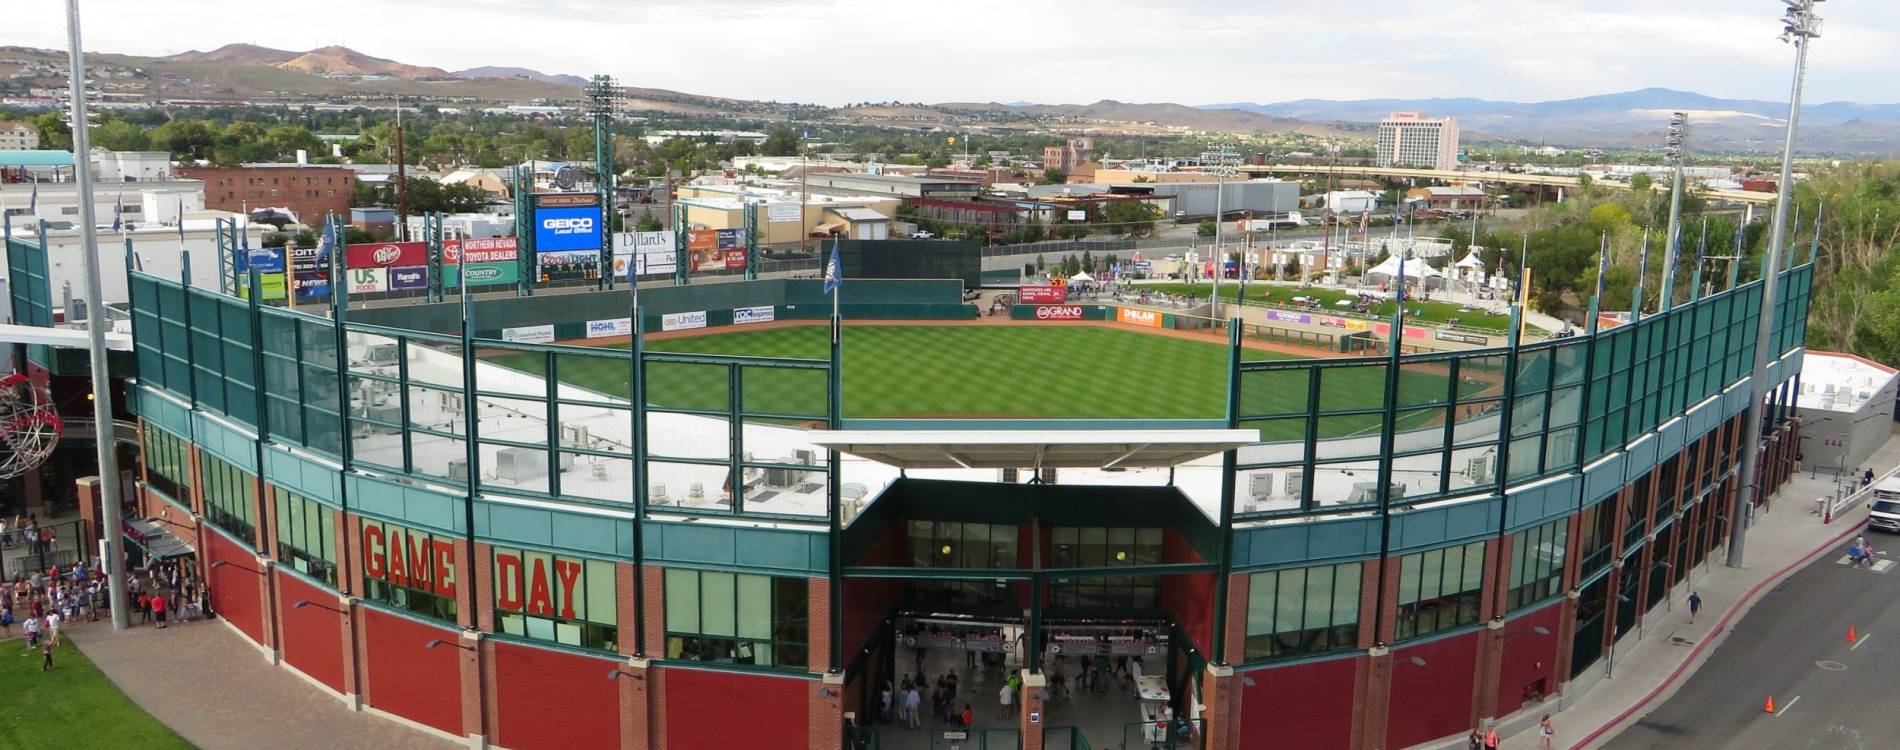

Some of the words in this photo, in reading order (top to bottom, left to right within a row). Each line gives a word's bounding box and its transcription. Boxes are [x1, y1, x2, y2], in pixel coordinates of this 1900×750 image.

[543, 217, 593, 229] GEICO
[465, 239, 495, 249] NORTHERN
[495, 238, 517, 248] NEVADA
[623, 232, 666, 246] Dllard's
[376, 249, 398, 263] Pepper
[465, 251, 489, 262] TOYOTA
[490, 250, 517, 260] DEALERS
[571, 254, 597, 264] LIGHT
[465, 269, 497, 277] COUNTRY
[302, 280, 328, 288] NEWS
[1049, 307, 1082, 316] GRAND
[1124, 309, 1154, 320] DOLAN
[678, 312, 705, 325] United
[364, 523, 457, 598] GAME
[497, 553, 581, 619] DAY
